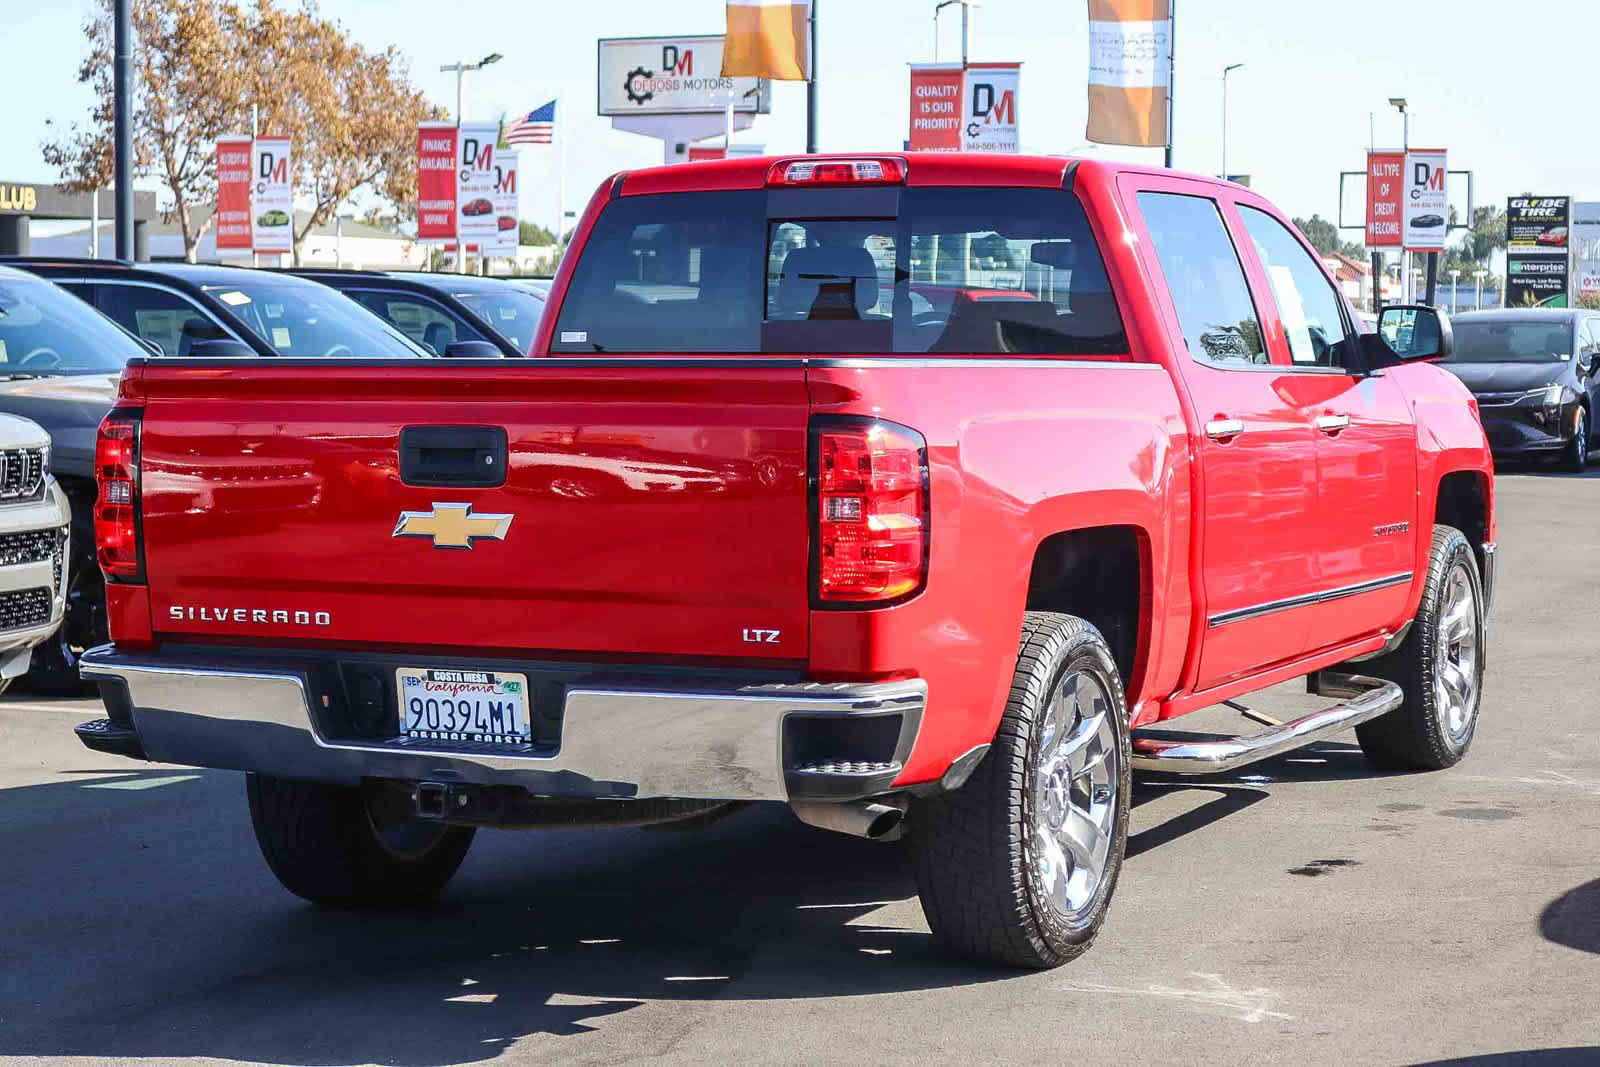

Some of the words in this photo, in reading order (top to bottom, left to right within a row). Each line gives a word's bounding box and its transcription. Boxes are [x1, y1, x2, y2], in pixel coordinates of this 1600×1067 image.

[634, 80, 680, 92] DEBOSS
[683, 78, 733, 91] MOTORS
[916, 85, 958, 97] QUALITY
[921, 102, 930, 112] IS
[932, 102, 953, 112] OUR
[915, 118, 960, 129] PRIORITY
[169, 606, 331, 625] SILVERADO
[743, 629, 780, 643] LTZ
[434, 671, 462, 682] COSTA
[464, 673, 489, 683] MESA
[425, 682, 504, 697] California
[410, 697, 521, 735] 90394M1
